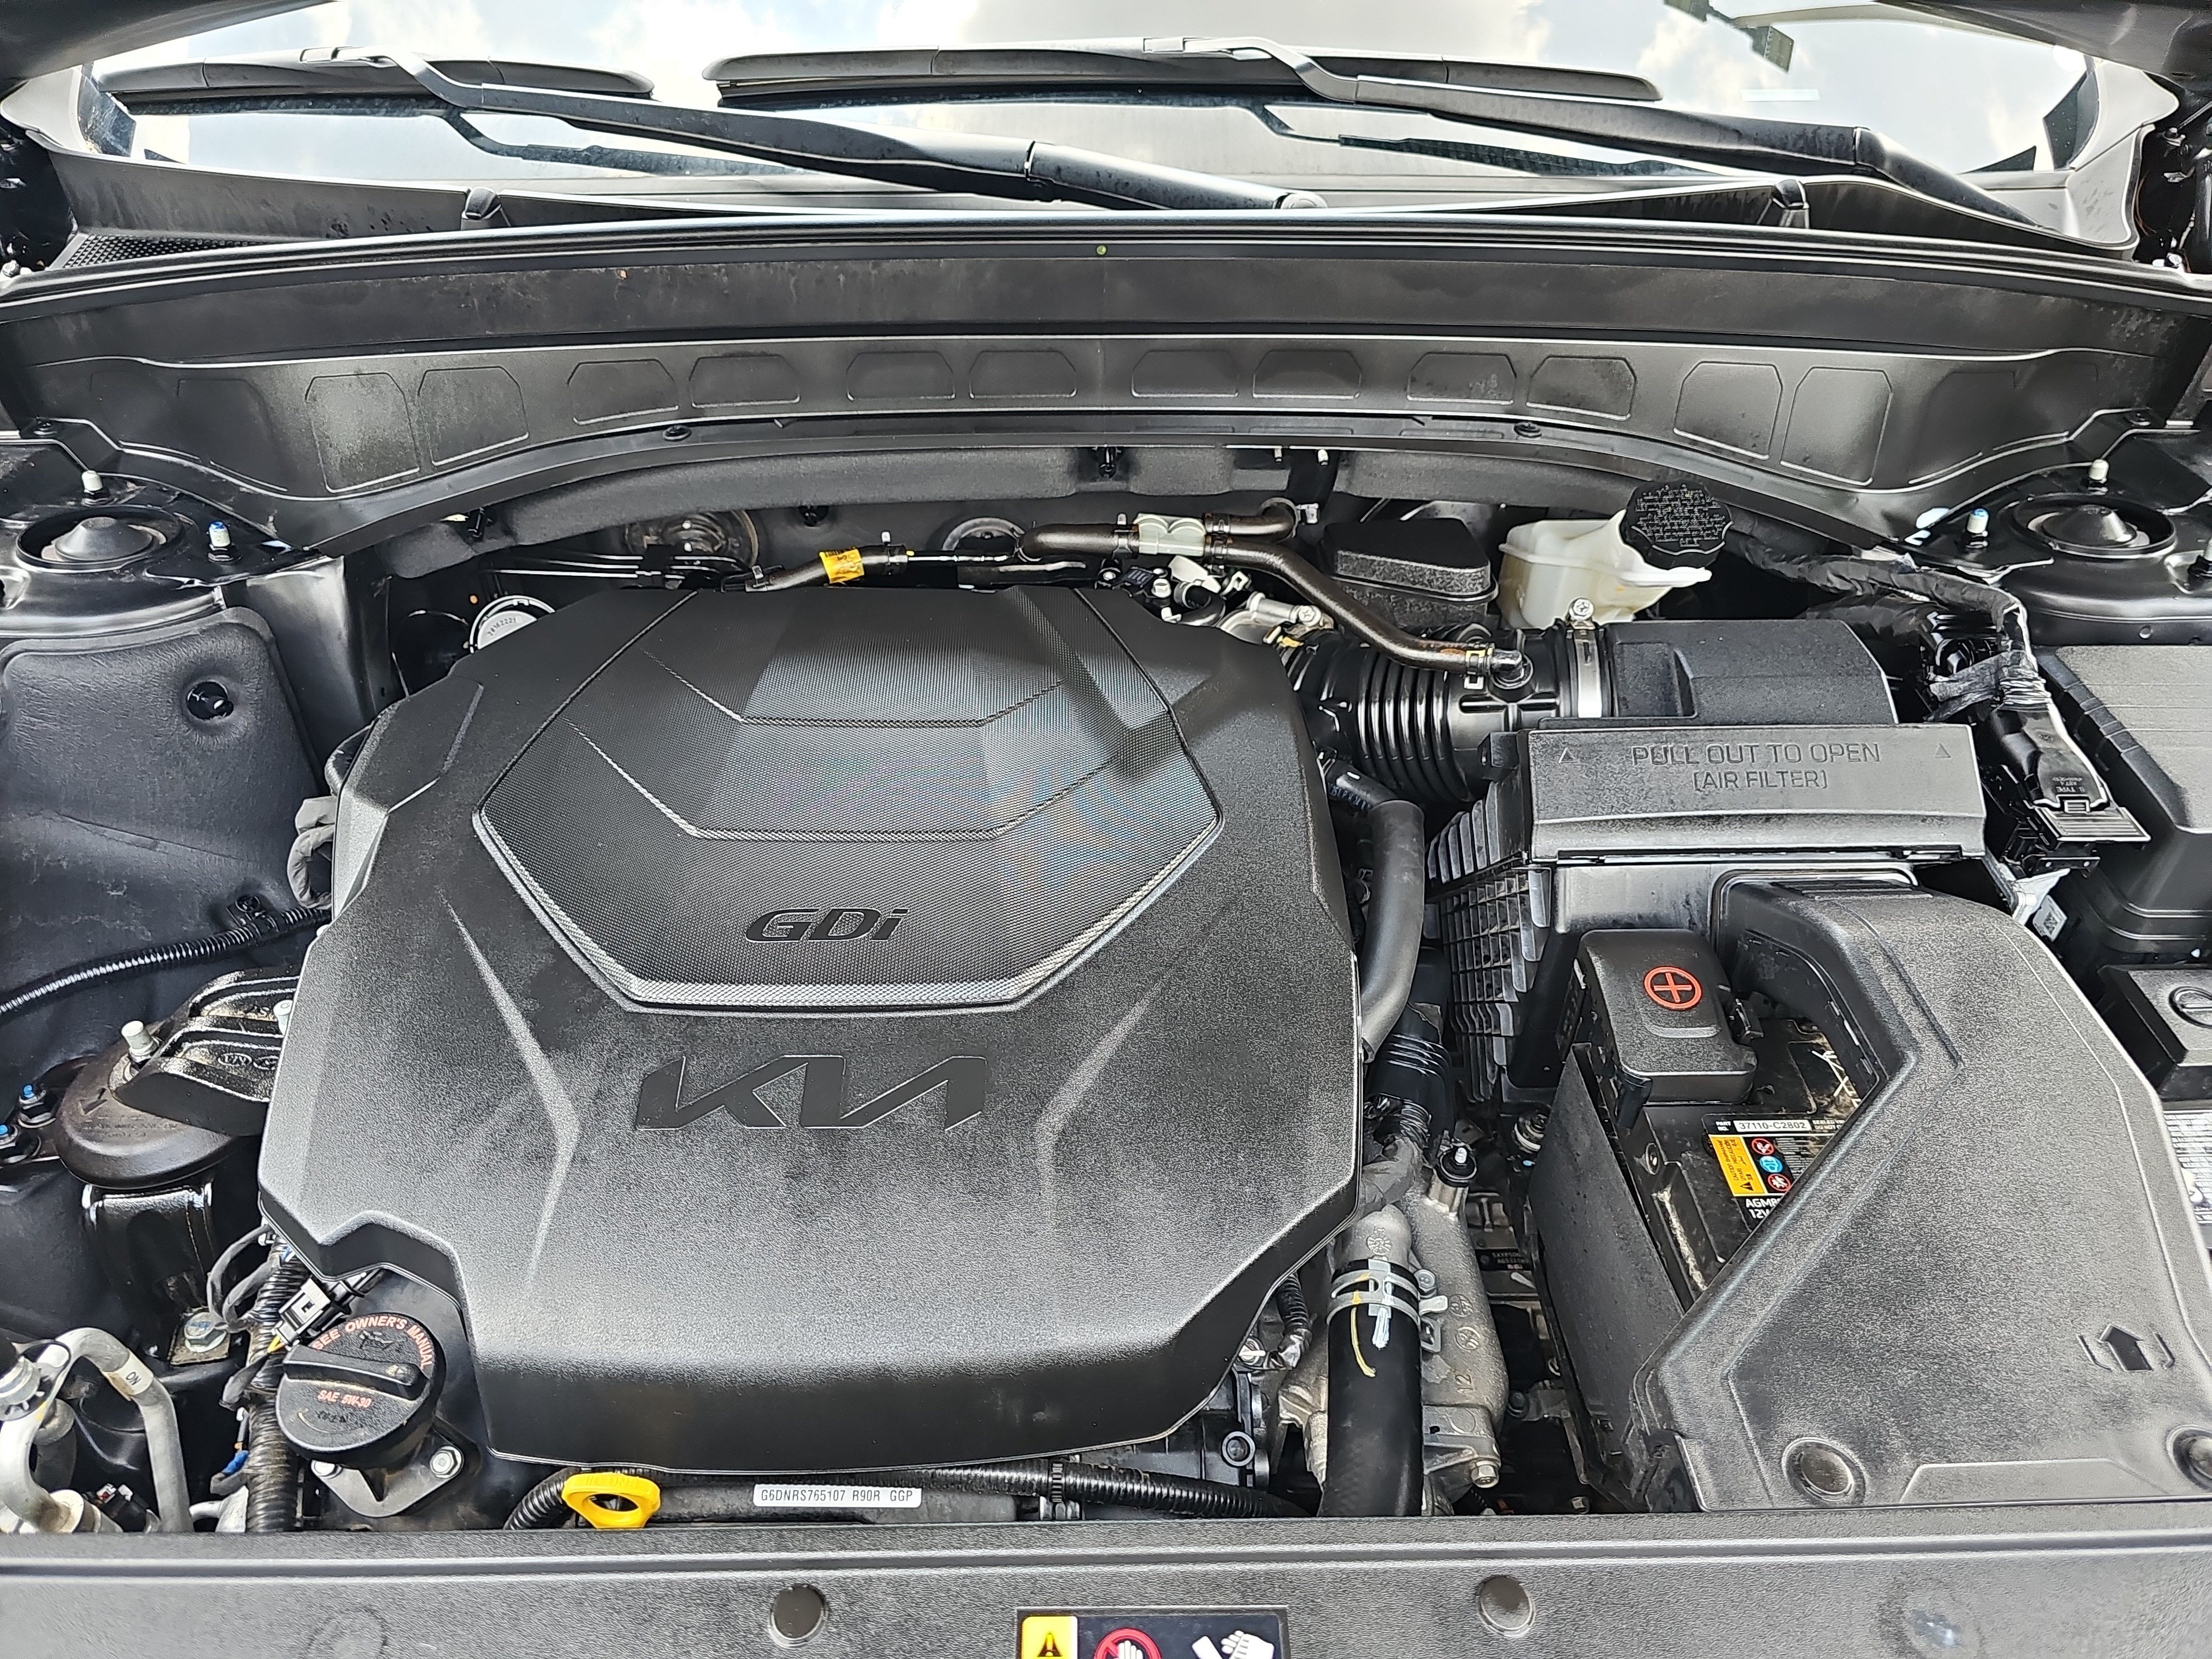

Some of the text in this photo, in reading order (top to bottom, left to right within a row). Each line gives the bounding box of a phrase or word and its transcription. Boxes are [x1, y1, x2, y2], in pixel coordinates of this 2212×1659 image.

[1631, 742, 1880, 765] PULL OUT TO OPEN
[746, 907, 911, 942] GDi
[635, 1054, 987, 1130] KIA
[1738, 1122, 1808, 1130] 37110-C2802
[1727, 1163, 1739, 1181] CAUTION
[307, 1315, 434, 1370] SEE OWNER'S MANUAL
[317, 1390, 372, 1409] SAE 5W-30
[761, 1489, 912, 1502] G6DNRS765107 R90R GGP
